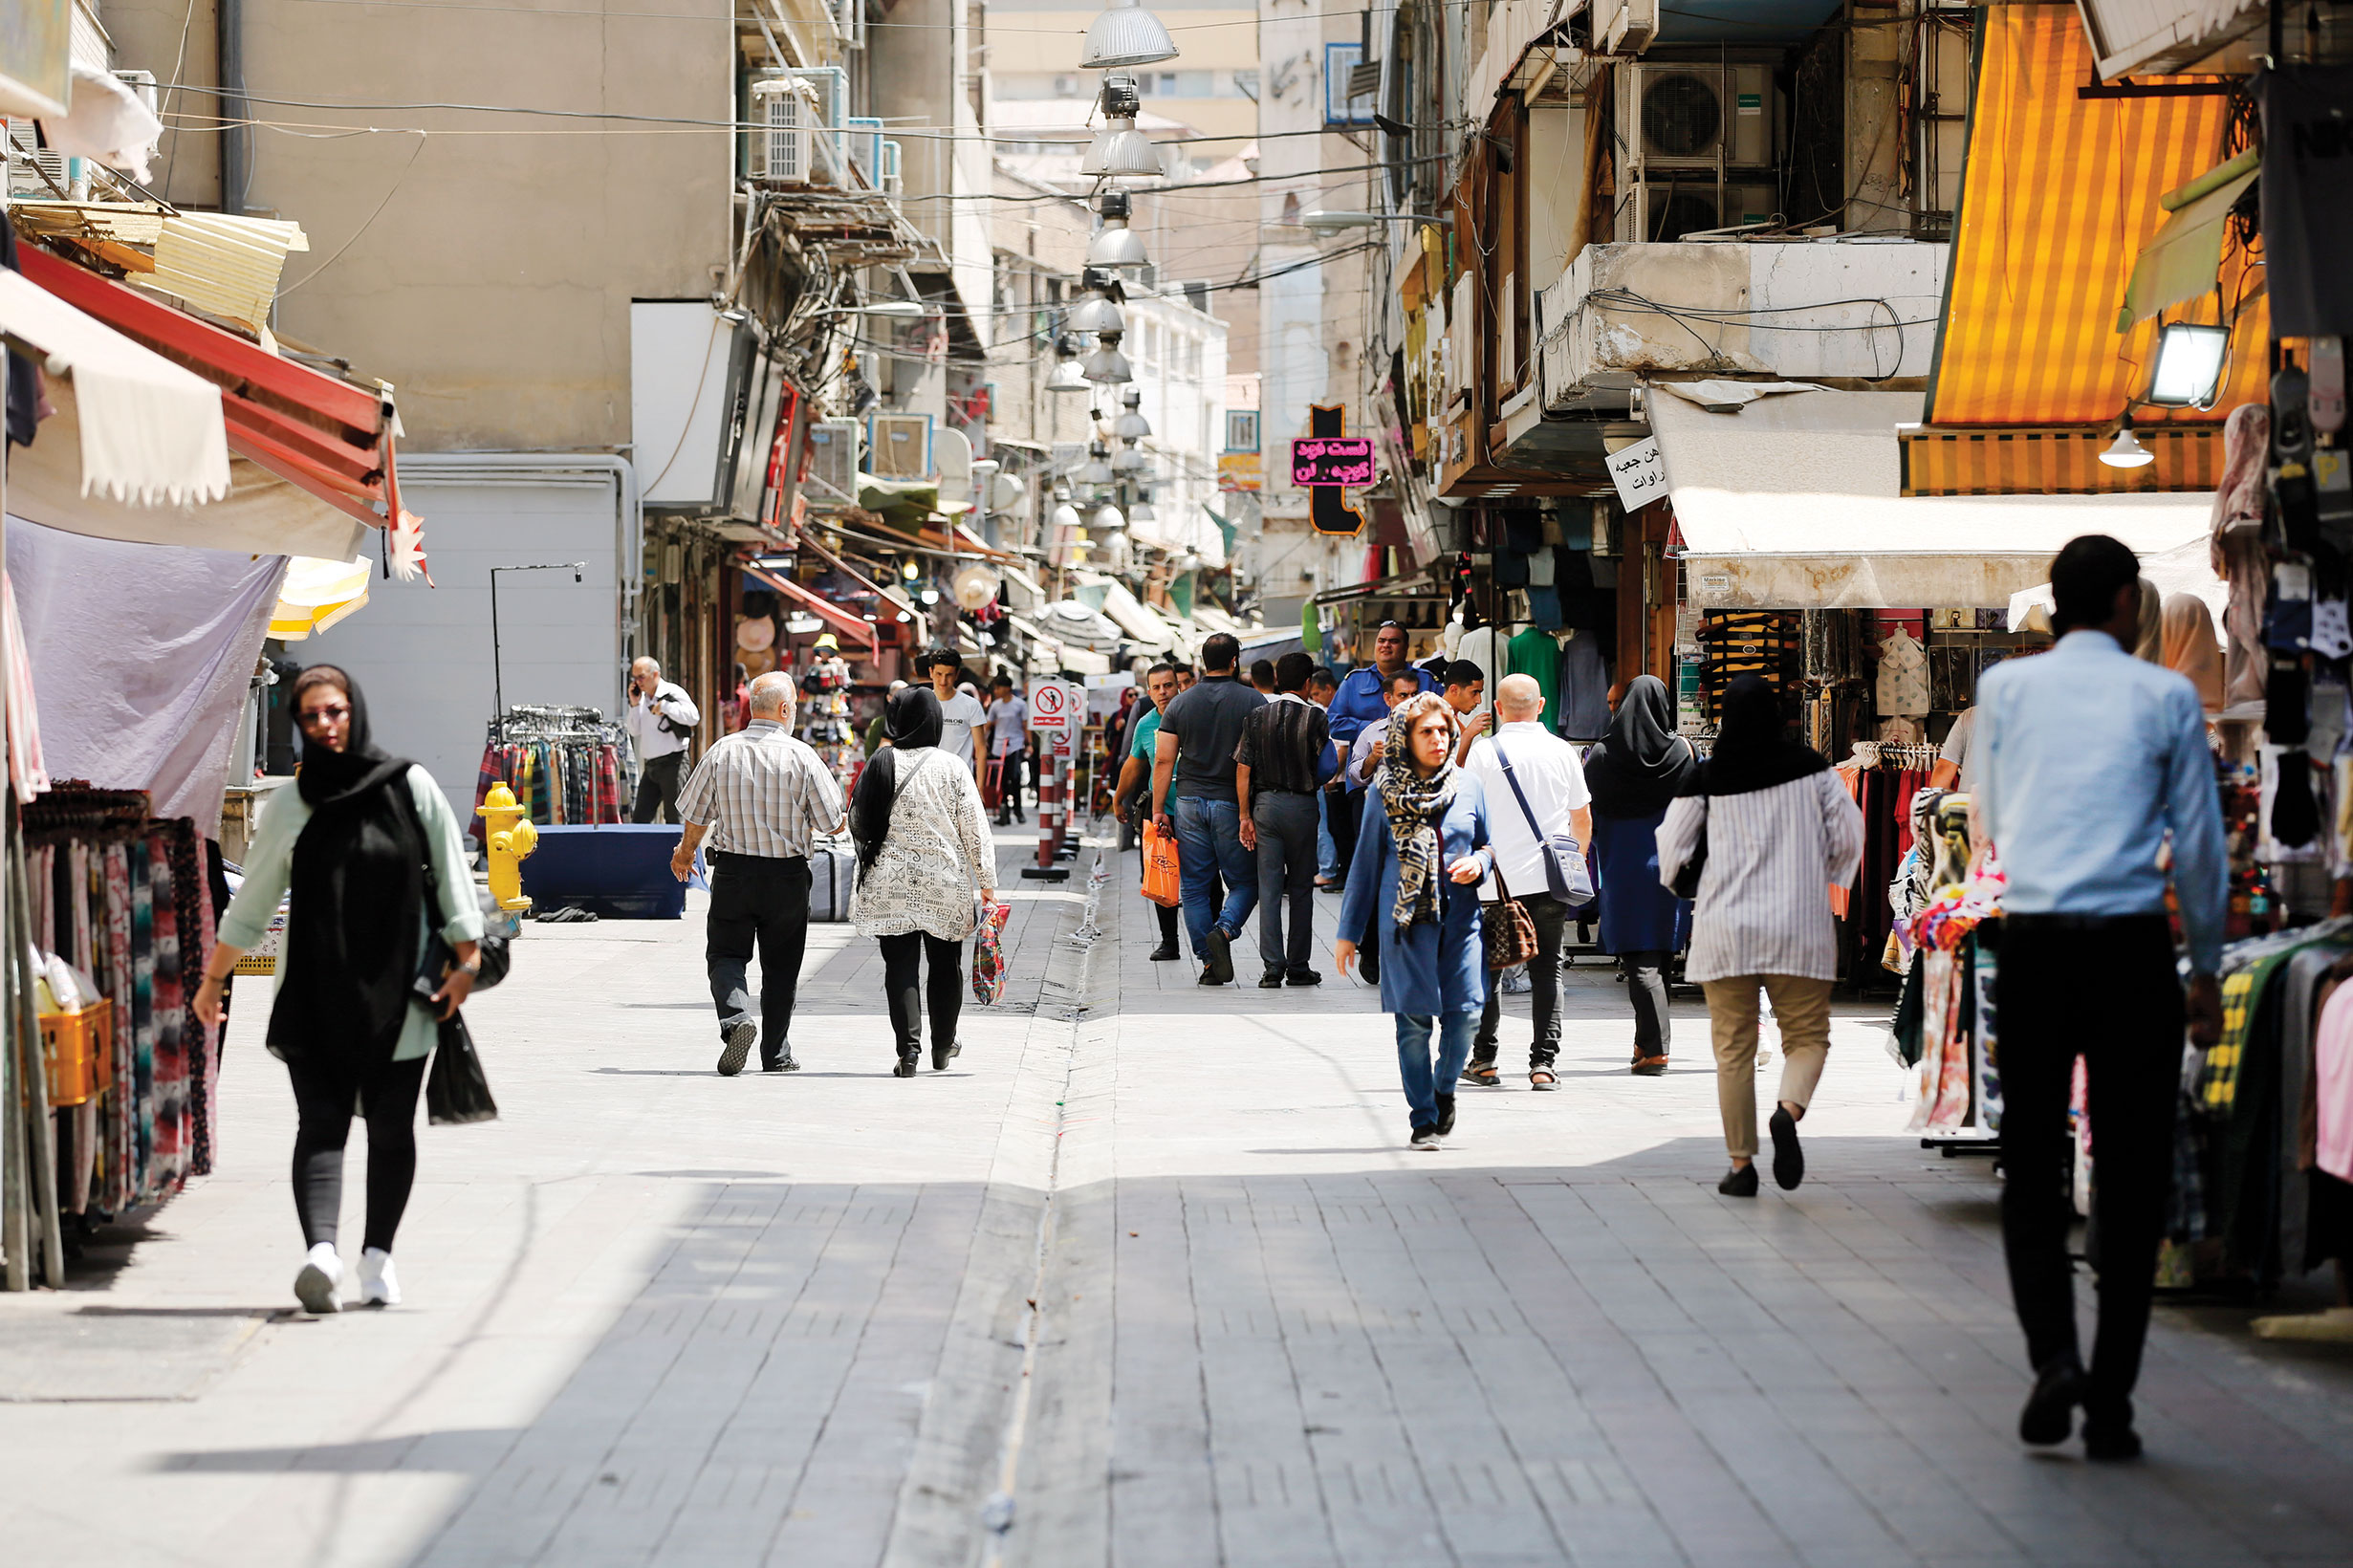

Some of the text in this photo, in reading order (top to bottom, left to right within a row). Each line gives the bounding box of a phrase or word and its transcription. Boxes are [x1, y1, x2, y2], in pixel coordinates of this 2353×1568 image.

[1297, 441, 1368, 460] فست فود
[1616, 458, 1641, 473] جعبه
